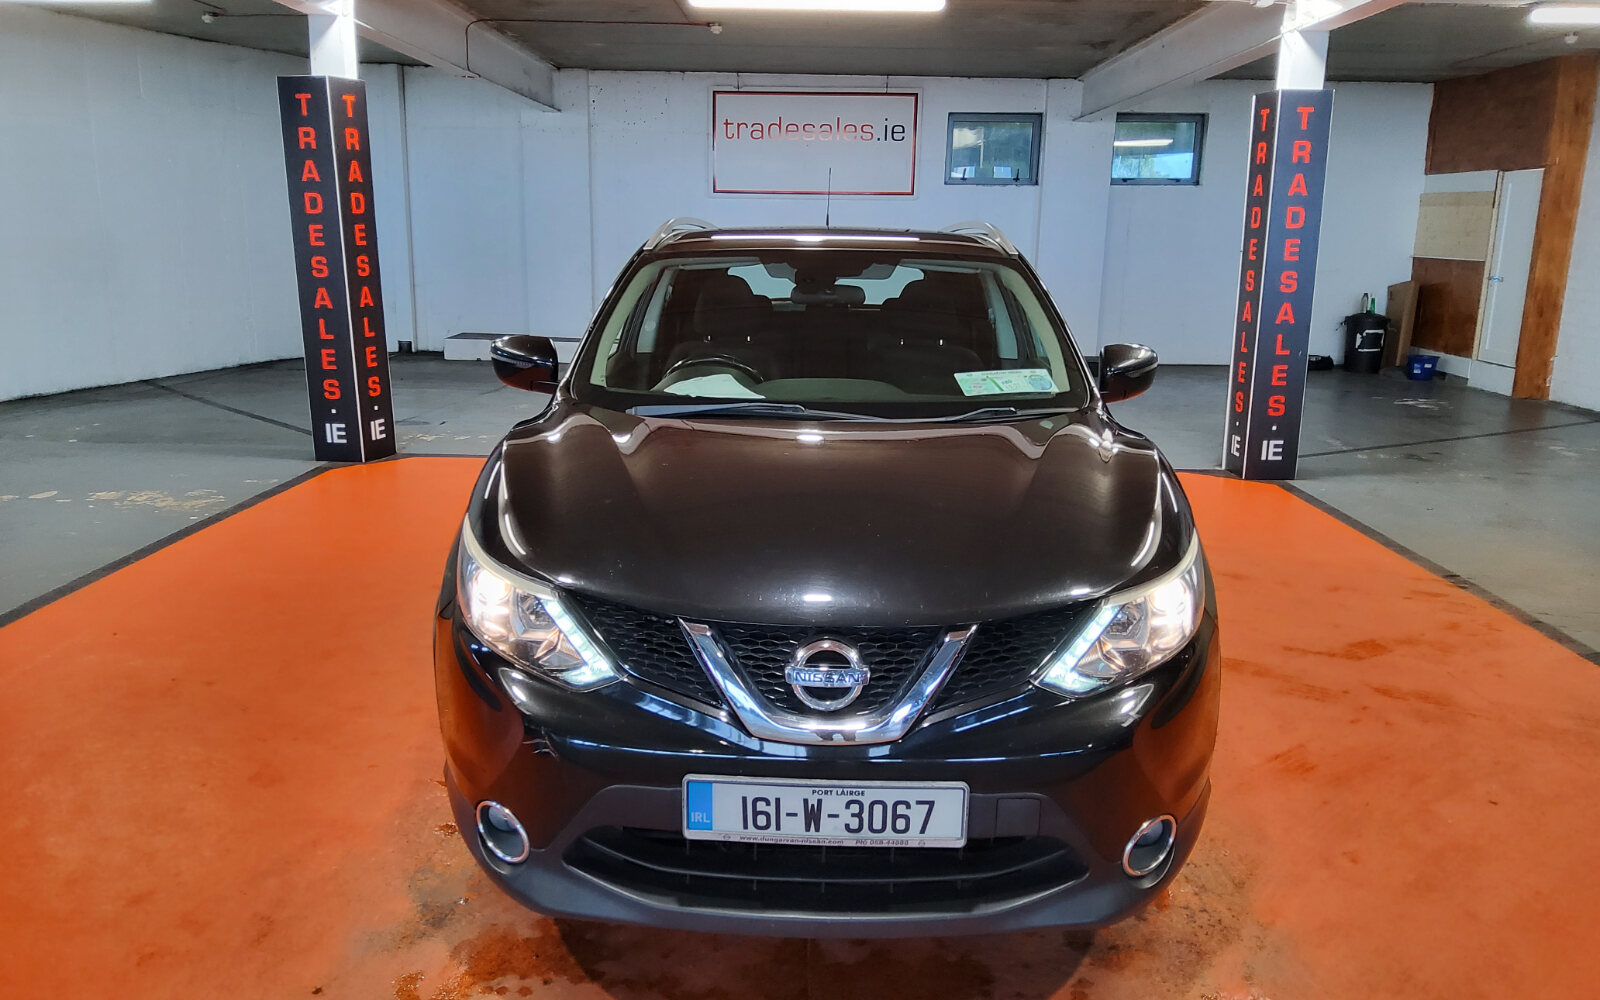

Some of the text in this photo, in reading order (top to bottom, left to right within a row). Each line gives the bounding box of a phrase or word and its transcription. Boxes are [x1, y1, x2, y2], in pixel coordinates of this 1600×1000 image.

[723, 116, 906, 142] tradesales.ie
[794, 670, 861, 684] NISSAN
[690, 811, 711, 823] IRL
[741, 795, 936, 835] 161-W-3067
